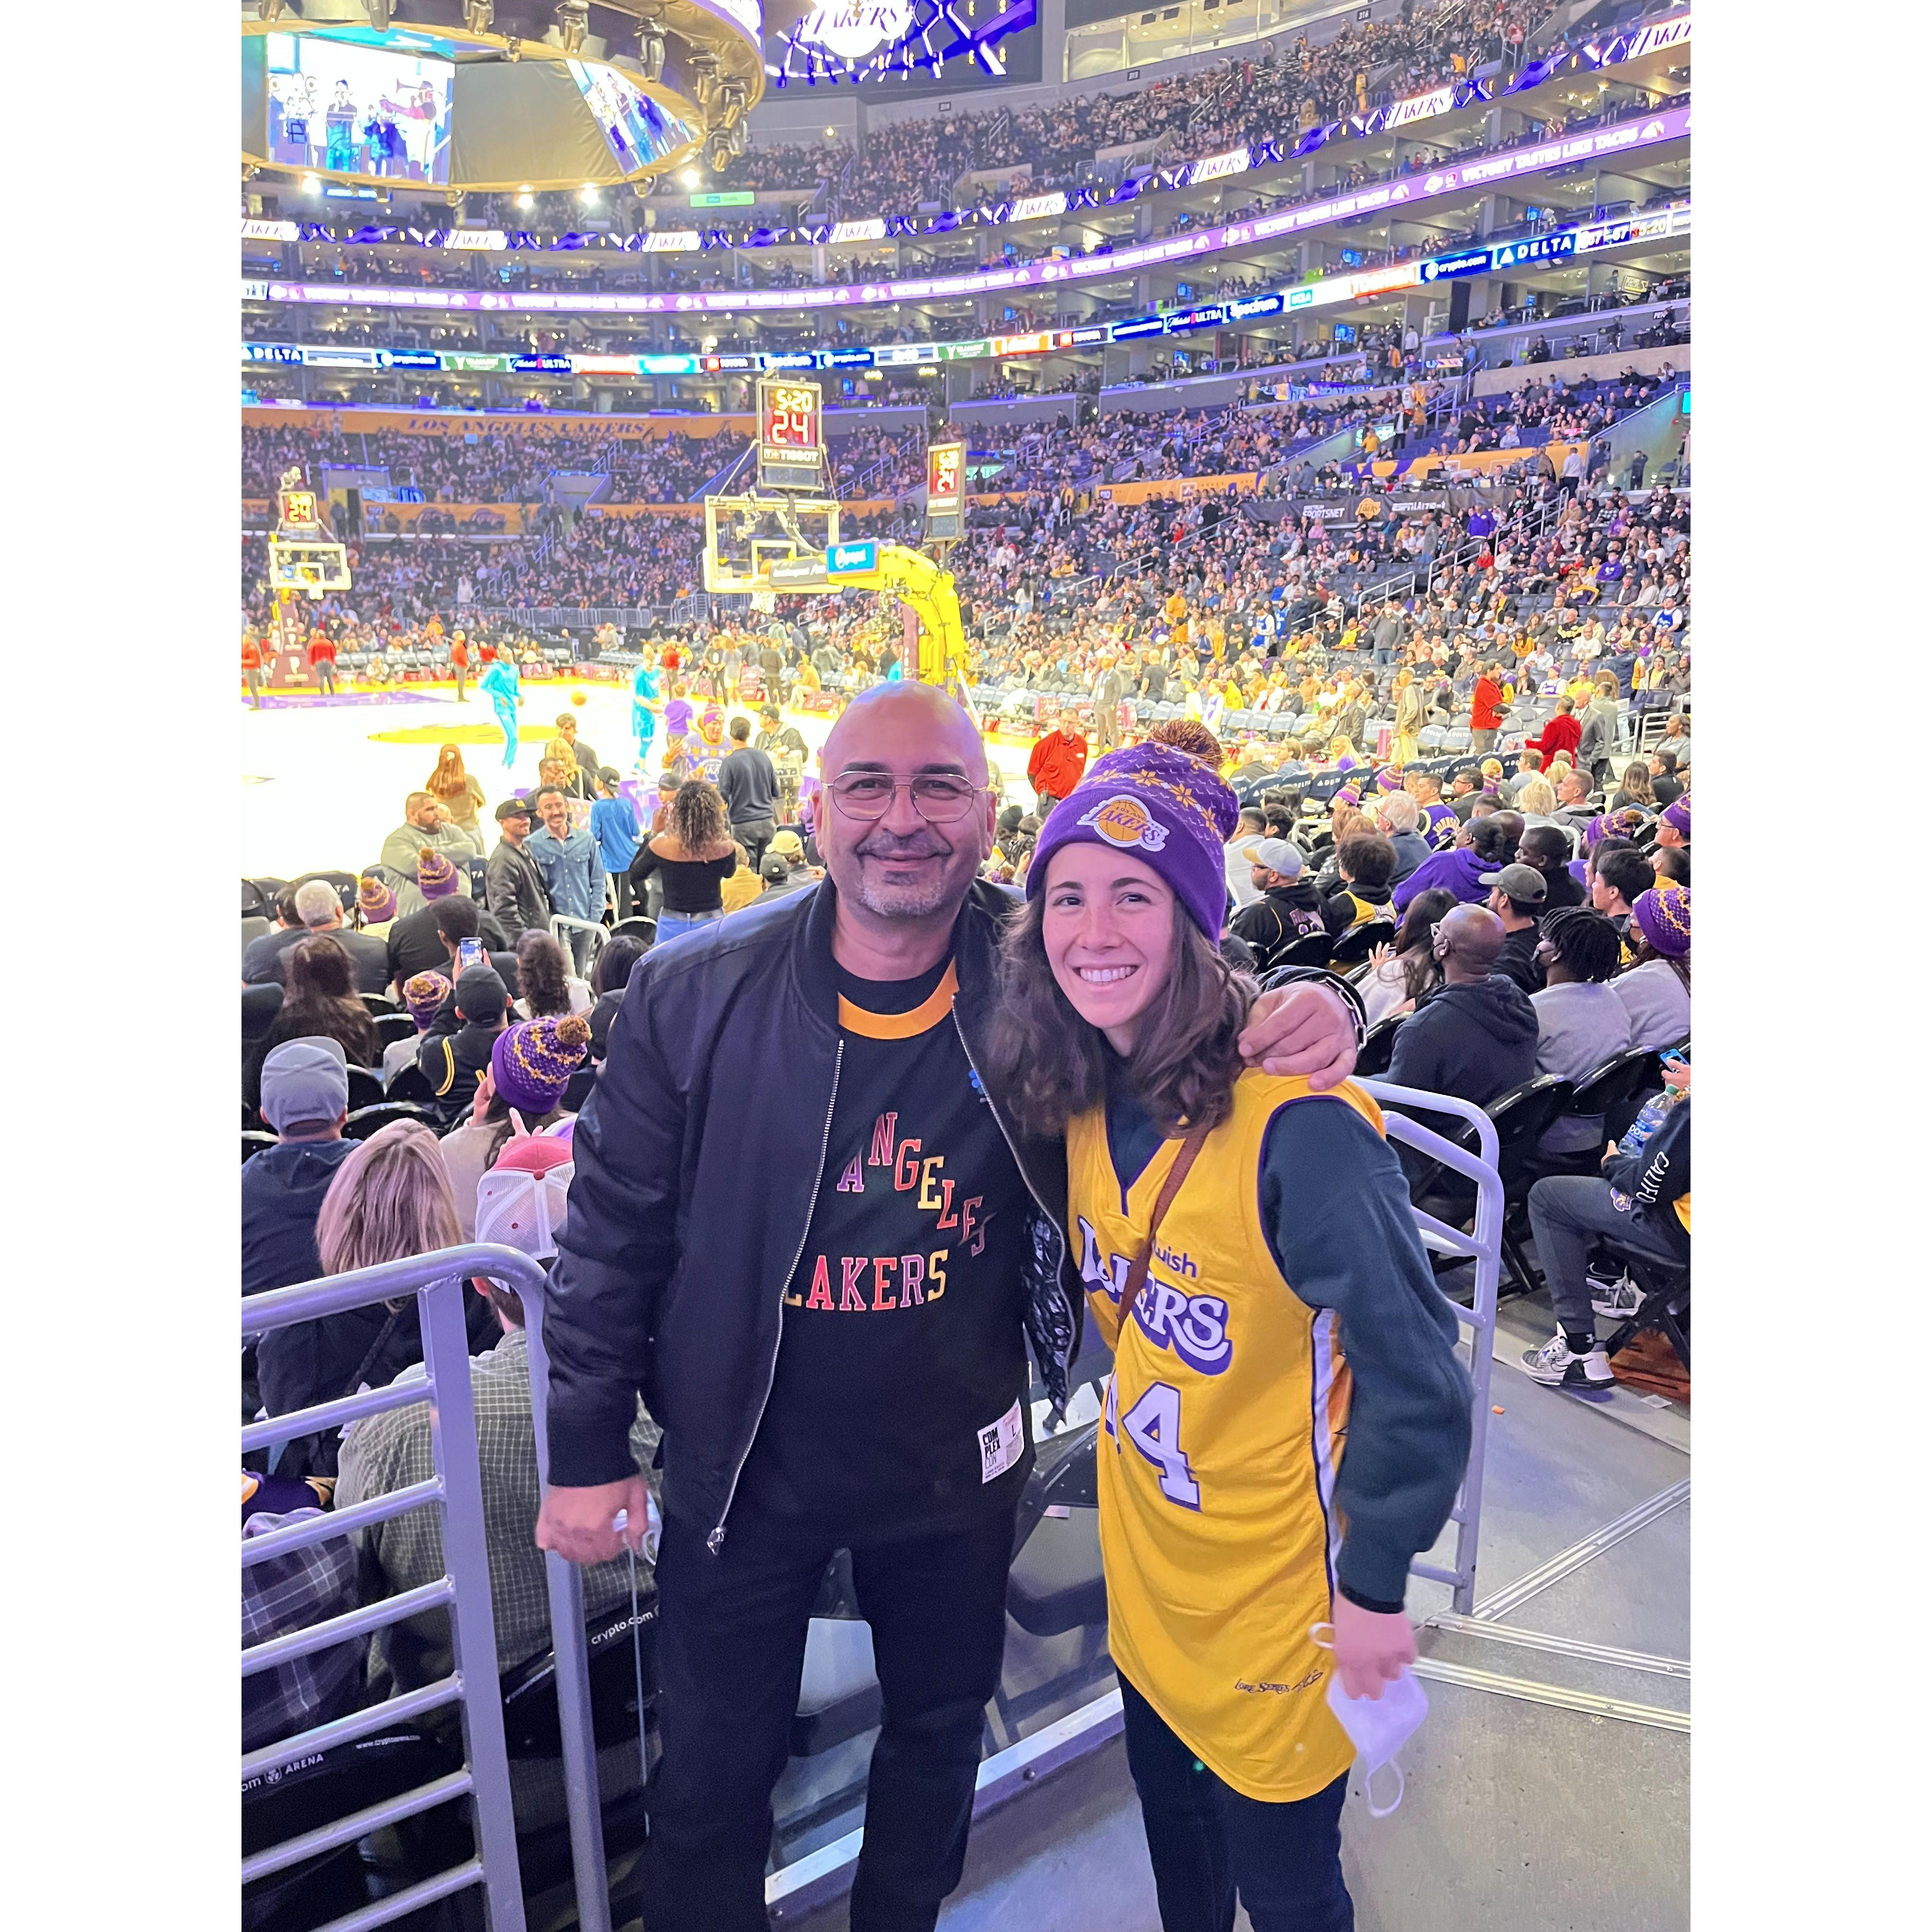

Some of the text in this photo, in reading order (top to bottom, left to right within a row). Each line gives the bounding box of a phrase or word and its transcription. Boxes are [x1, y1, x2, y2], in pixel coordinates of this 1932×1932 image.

[1461, 127, 1638, 183] VICTORY TASTES LIKE TACOS
[1517, 236, 1572, 259] DELTA
[1438, 255, 1486, 273] crypto.com
[1195, 309, 1222, 324] ULTRA
[1230, 298, 1279, 319] Spectrum
[253, 347, 301, 361] DELTA
[775, 387, 813, 413] 5:20
[409, 419, 449, 430] LOS
[559, 422, 646, 433] LAKERS
[772, 410, 809, 444] 24
[780, 450, 819, 462] TISSOT
[288, 503, 311, 522] 24
[1302, 508, 1345, 519] SPORTSNET
[1088, 804, 1161, 845] LAKERS
[1154, 1245, 1197, 1278] wish
[982, 1426, 999, 1446] COM
[985, 1438, 1001, 1458] PLEX
[985, 1452, 997, 1469] CON
[591, 1611, 654, 1645] crypto.com
[285, 1753, 324, 1774] ARENA
